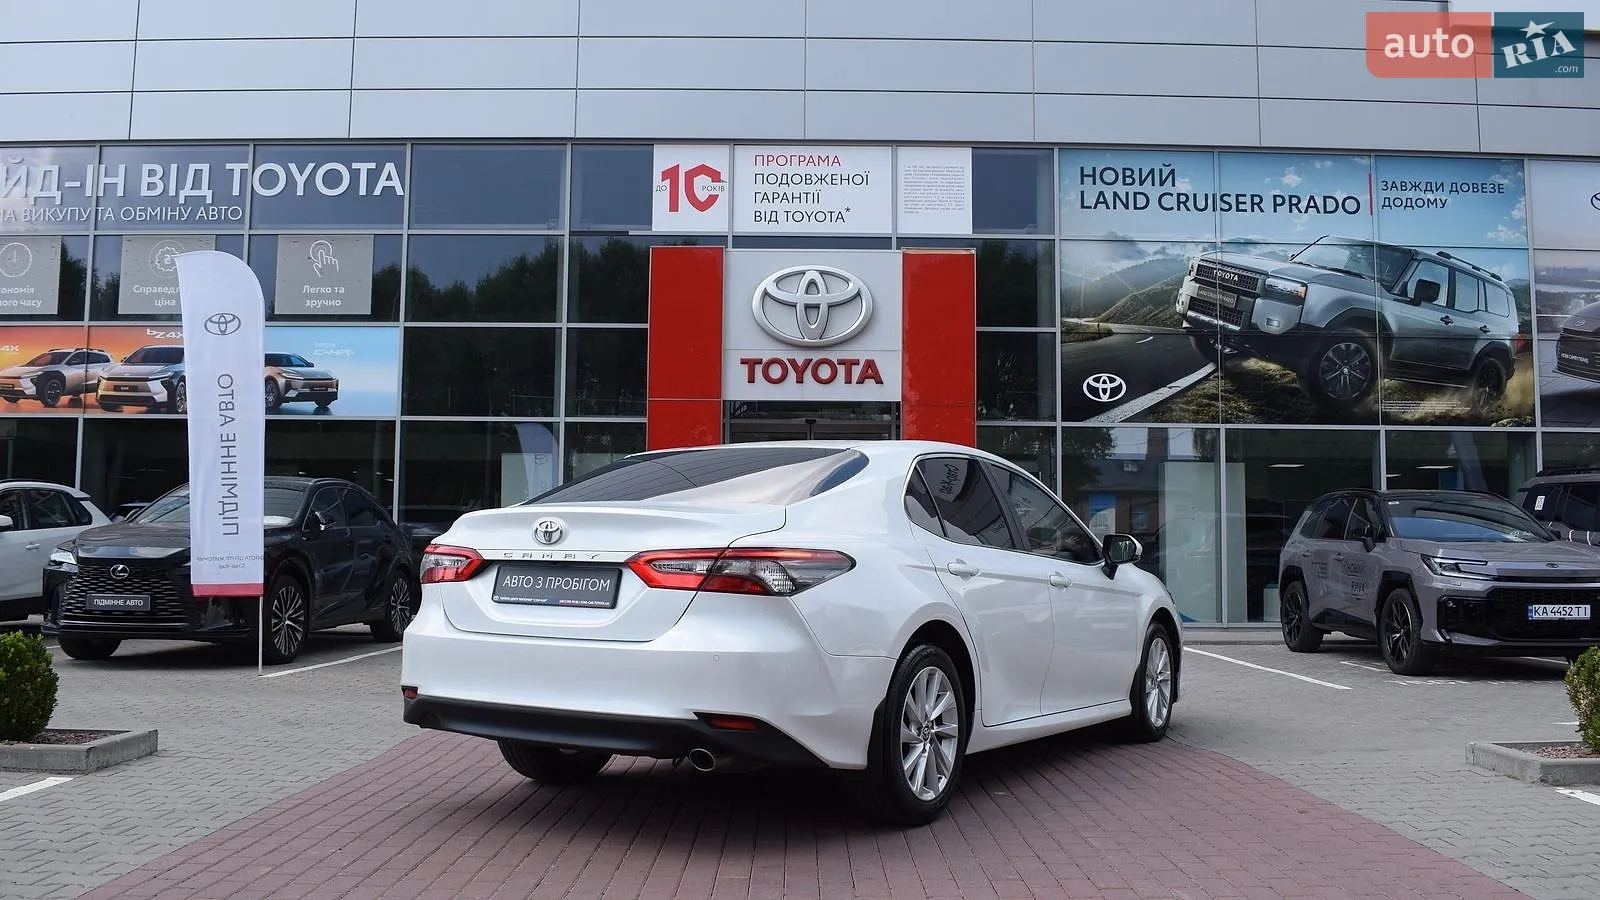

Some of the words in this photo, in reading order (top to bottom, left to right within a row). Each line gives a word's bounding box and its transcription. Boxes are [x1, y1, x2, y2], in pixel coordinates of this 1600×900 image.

[754, 154, 841, 168] ПРОГРАМА
[140, 162, 214, 204] ВІД
[226, 161, 405, 198] TOYOTA
[754, 170, 870, 187] ПОДОВЖЕНОЇ
[1079, 163, 1177, 188] НОВИЙ
[655, 184, 668, 193] ДО
[661, 163, 722, 213] 10
[701, 184, 726, 192] РОКІВ
[1381, 179, 1445, 195] ЗАВЖДИ
[1449, 181, 1505, 196] ДОВЕЗЕ
[754, 189, 821, 204] ГАРАНТІЇ
[1079, 190, 1150, 212] LAND
[1157, 191, 1265, 213] CRUISER
[1272, 193, 1361, 216] PRADO
[1381, 196, 1449, 211] ДОДОМУ
[22, 206, 91, 223] ВИКУПУ
[97, 206, 115, 222] ТА
[120, 205, 192, 222] ОБМІНУ
[196, 205, 243, 221] АВТО
[754, 210, 779, 225] ВІД
[0, 284, 35, 294] ономія
[302, 284, 332, 295] Легко
[333, 286, 345, 294] та
[154, 297, 177, 308] ціна
[304, 299, 342, 309] зручно
[740, 356, 884, 385] TOYOTA
[503, 575, 534, 588] АВТО
[546, 576, 611, 592] ПРОБІГОМ
[94, 598, 124, 607] ПІДМІННЕ
[125, 598, 144, 607] АВТО
[1534, 606, 1548, 617] KA
[1550, 606, 1574, 617] 4452
